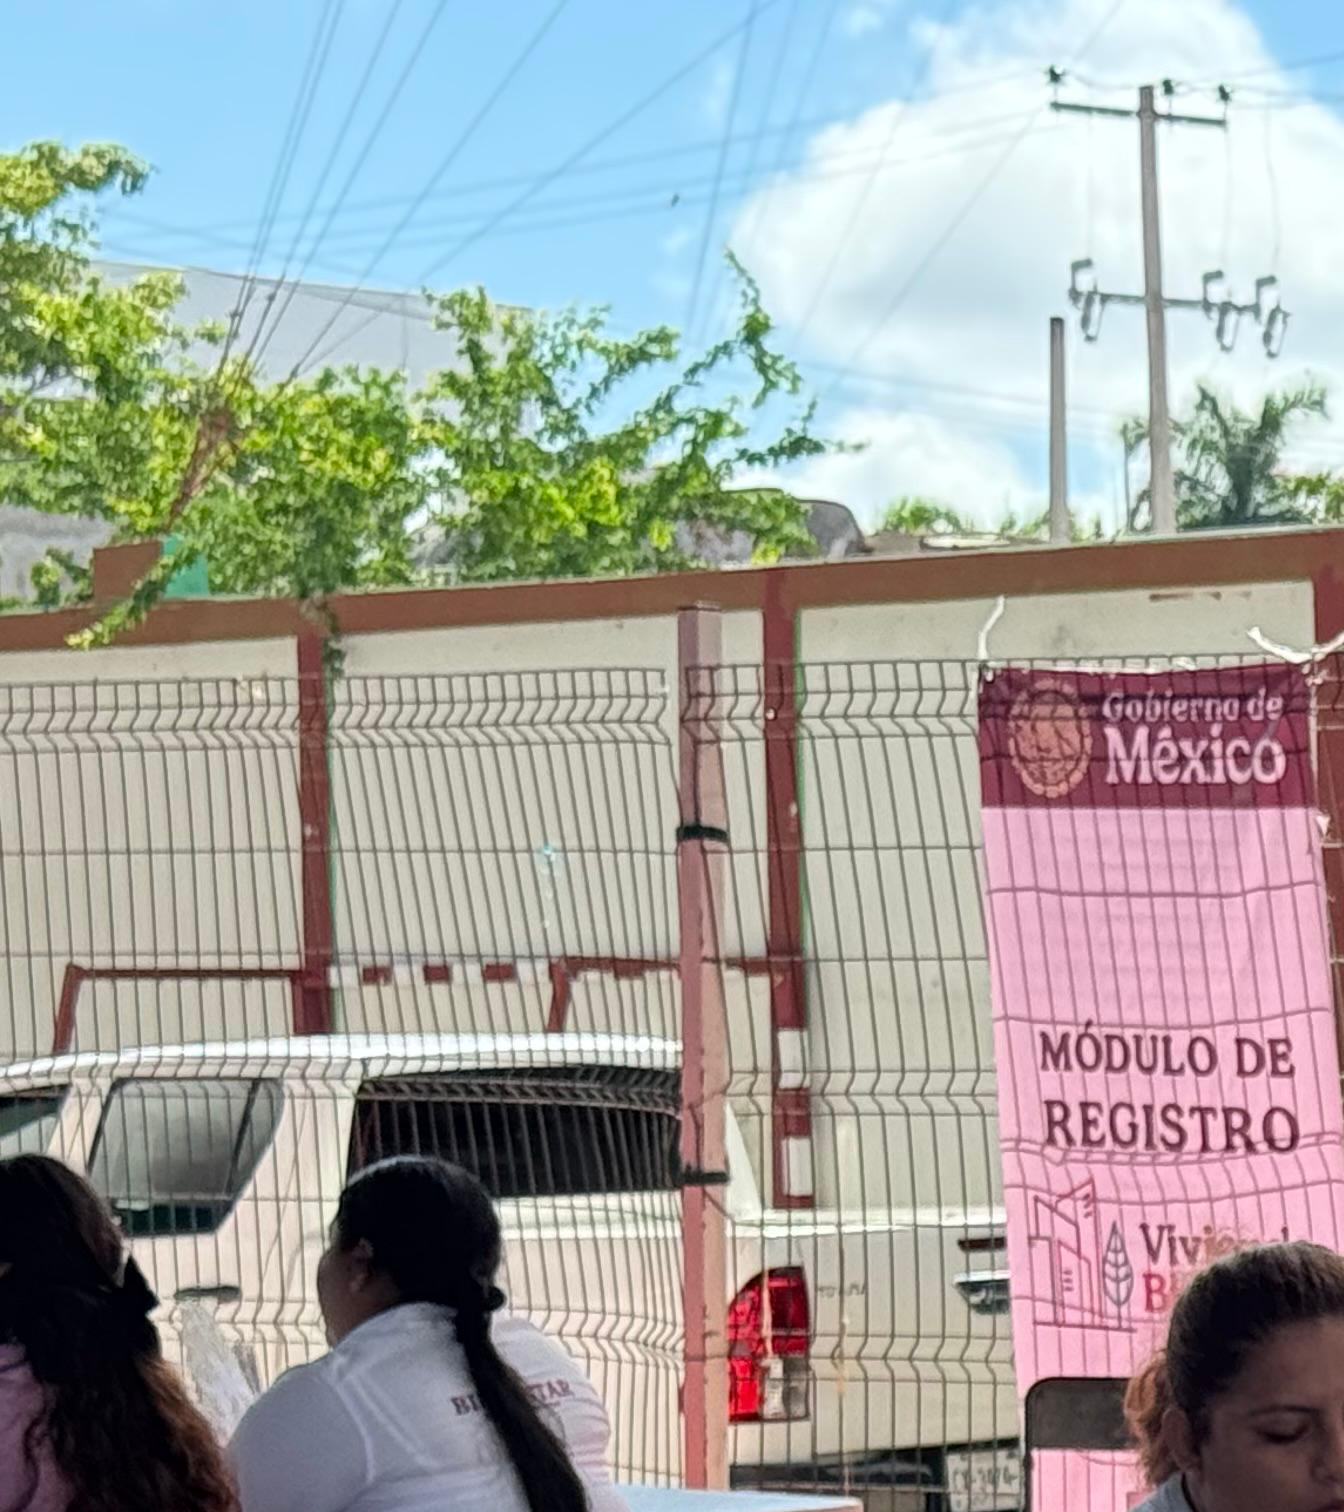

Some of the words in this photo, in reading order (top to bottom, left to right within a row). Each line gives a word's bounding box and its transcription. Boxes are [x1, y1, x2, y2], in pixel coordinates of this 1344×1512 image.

[1102, 687, 1243, 723] Gobierno
[1247, 692, 1284, 722] de
[1103, 723, 1288, 786] México
[1040, 1018, 1219, 1077] MÓDULO
[1235, 1036, 1296, 1079] DE
[1044, 1099, 1300, 1154] REGISTRO
